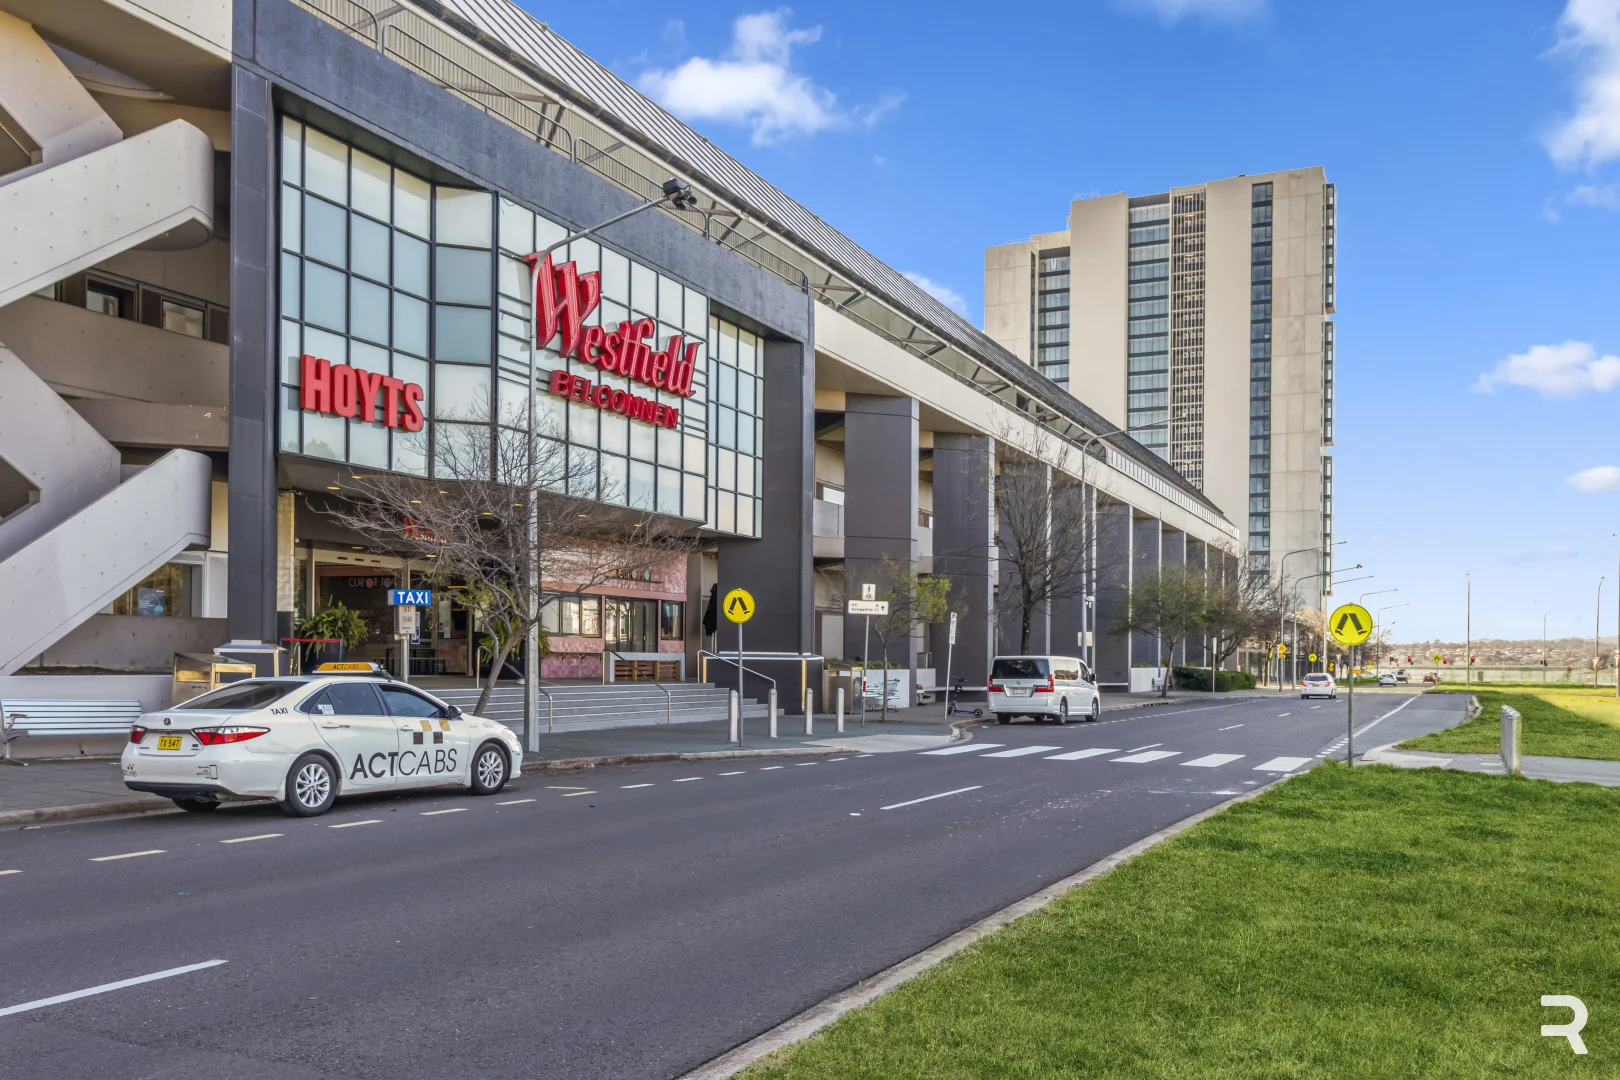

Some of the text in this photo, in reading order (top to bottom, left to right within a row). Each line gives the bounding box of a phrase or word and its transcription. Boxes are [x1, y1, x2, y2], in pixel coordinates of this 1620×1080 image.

[521, 251, 704, 398] Westfield
[300, 354, 424, 432] HOYTS
[549, 370, 679, 429] BELCONNEN
[397, 591, 429, 604] TAXI
[271, 707, 289, 715] TAXI
[349, 748, 458, 779] ACTCABS
